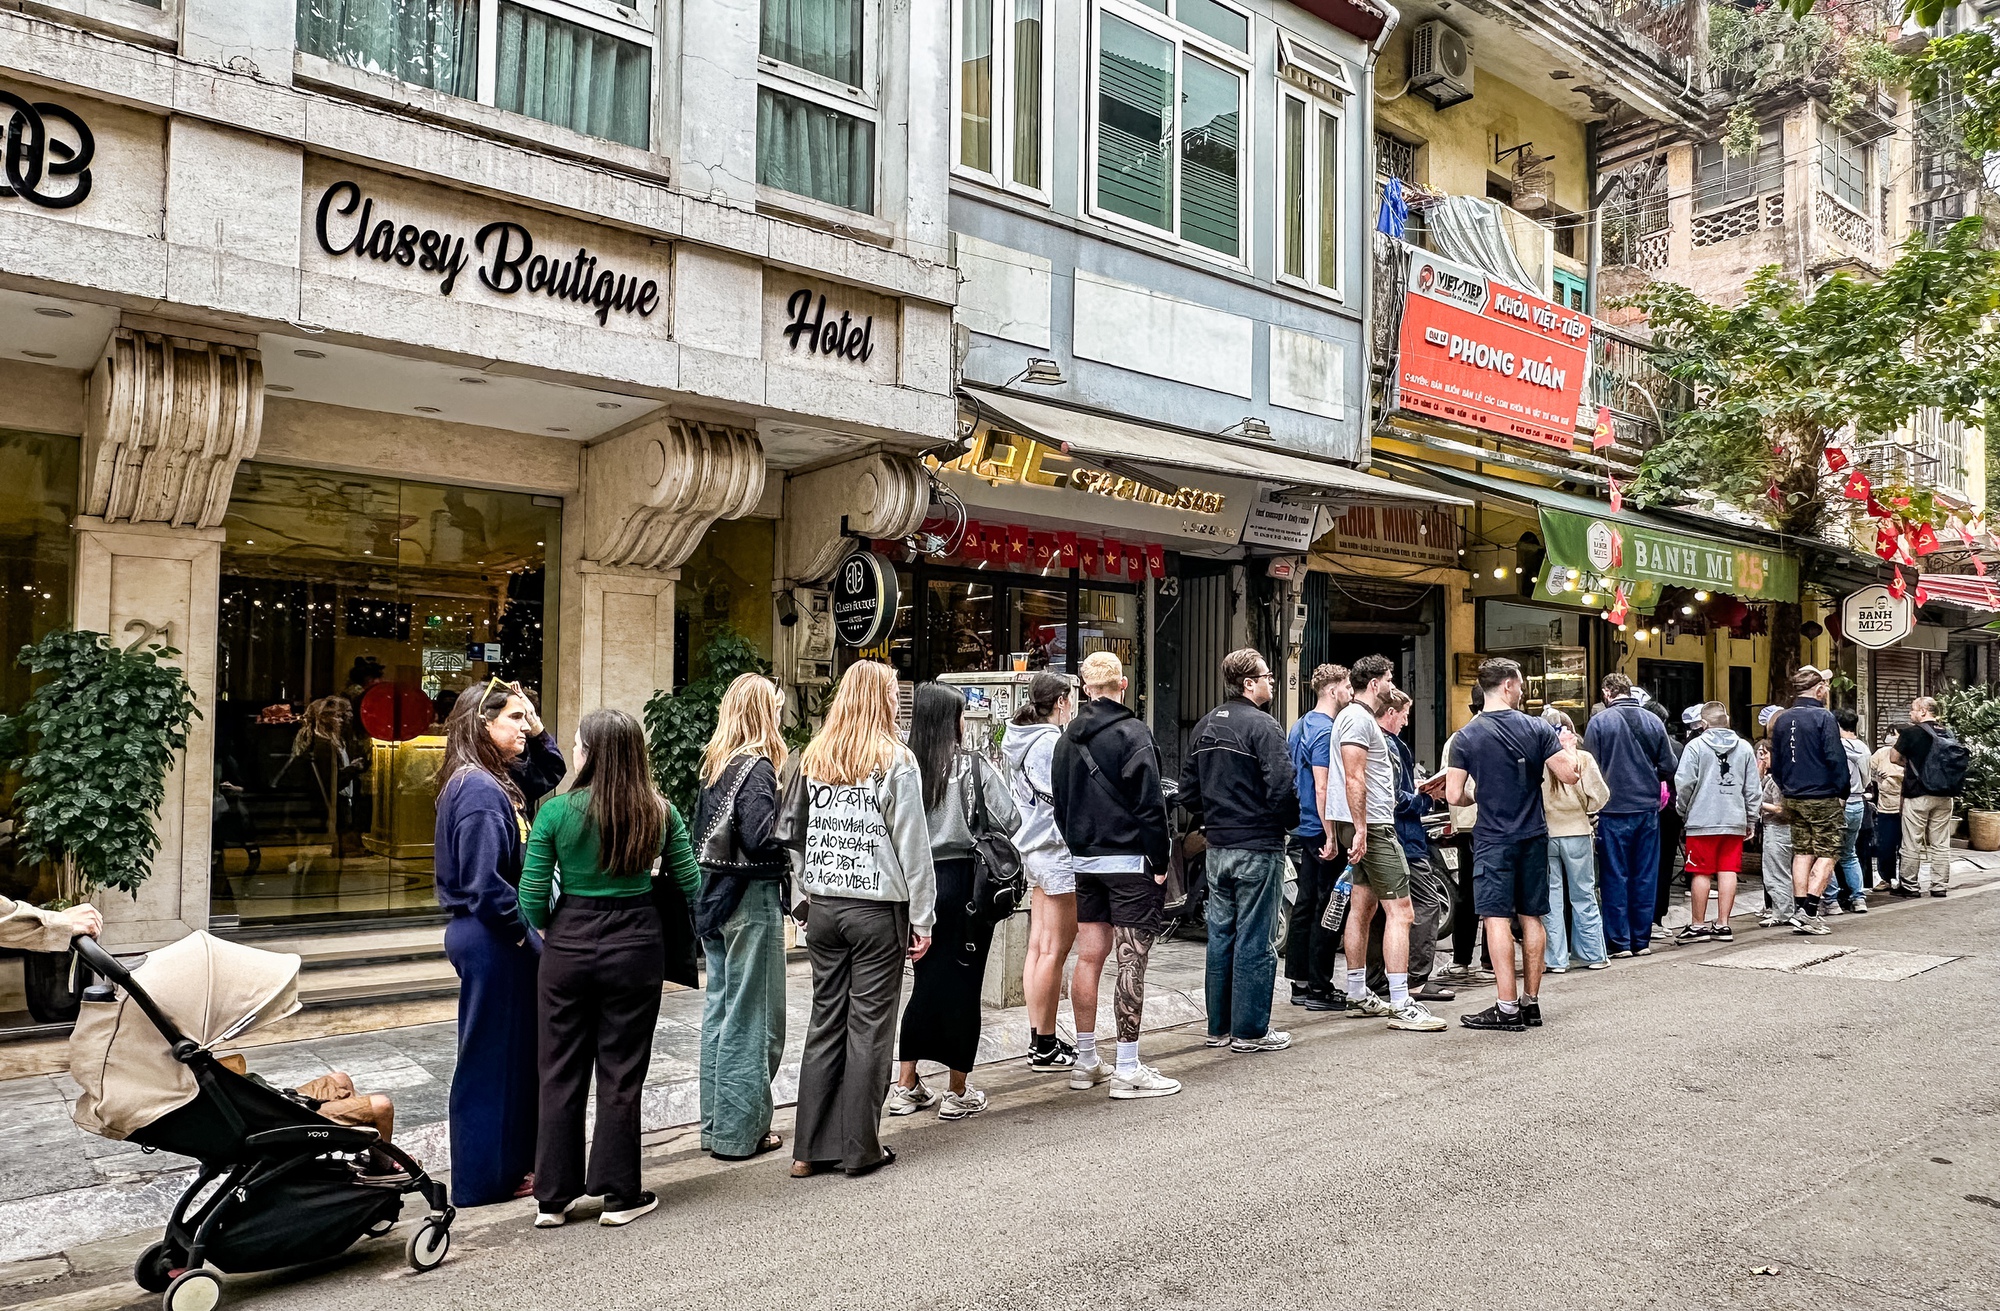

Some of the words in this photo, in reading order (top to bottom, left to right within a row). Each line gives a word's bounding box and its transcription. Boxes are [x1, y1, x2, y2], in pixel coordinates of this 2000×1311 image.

[315, 180, 469, 295] Classy
[474, 221, 660, 327] Boutique
[783, 289, 874, 363] Hotel
[1494, 292, 1530, 323] KHÓA
[1532, 304, 1586, 342] VIỆT-TIỆP
[1448, 334, 1515, 377] PHONG
[1517, 355, 1567, 392] XUÂN
[1159, 576, 1179, 597] 23
[1634, 540, 1697, 576] BANH
[1705, 553, 1733, 581] MI
[1737, 551, 1764, 590] 25
[1098, 594, 1117, 623] NAIL
[1859, 611, 1893, 619] BANH
[1859, 620, 1893, 632] MI25
[124, 618, 175, 657] 21
